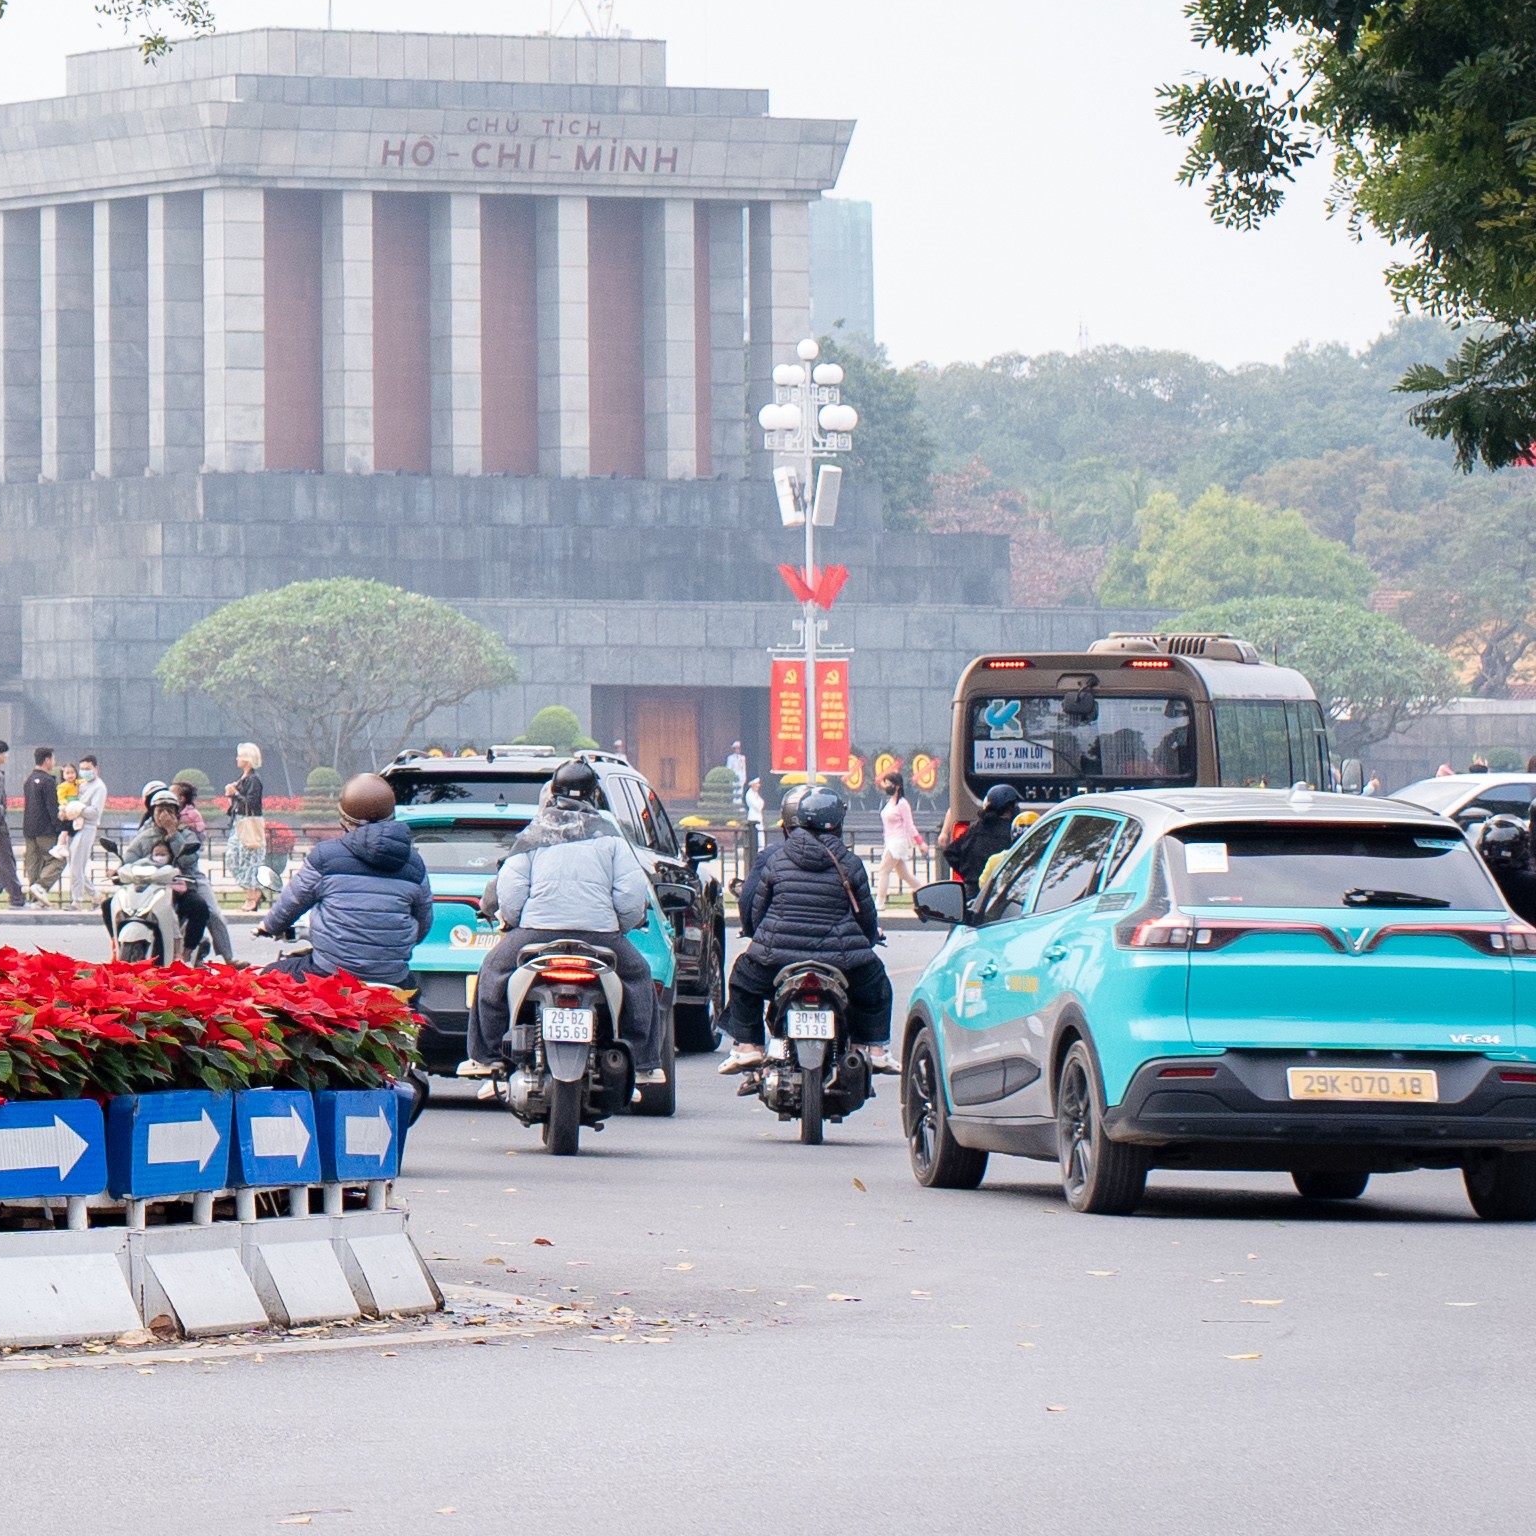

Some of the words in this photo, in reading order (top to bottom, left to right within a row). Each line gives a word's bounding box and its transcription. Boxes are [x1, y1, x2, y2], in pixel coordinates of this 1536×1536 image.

[984, 747, 994, 759] XE
[997, 747, 1007, 759] TO
[1014, 747, 1029, 759] XIN
[548, 1025, 588, 1040] 155.69
[795, 1024, 827, 1036] 5136
[1302, 1075, 1423, 1095] 29K-070.18
